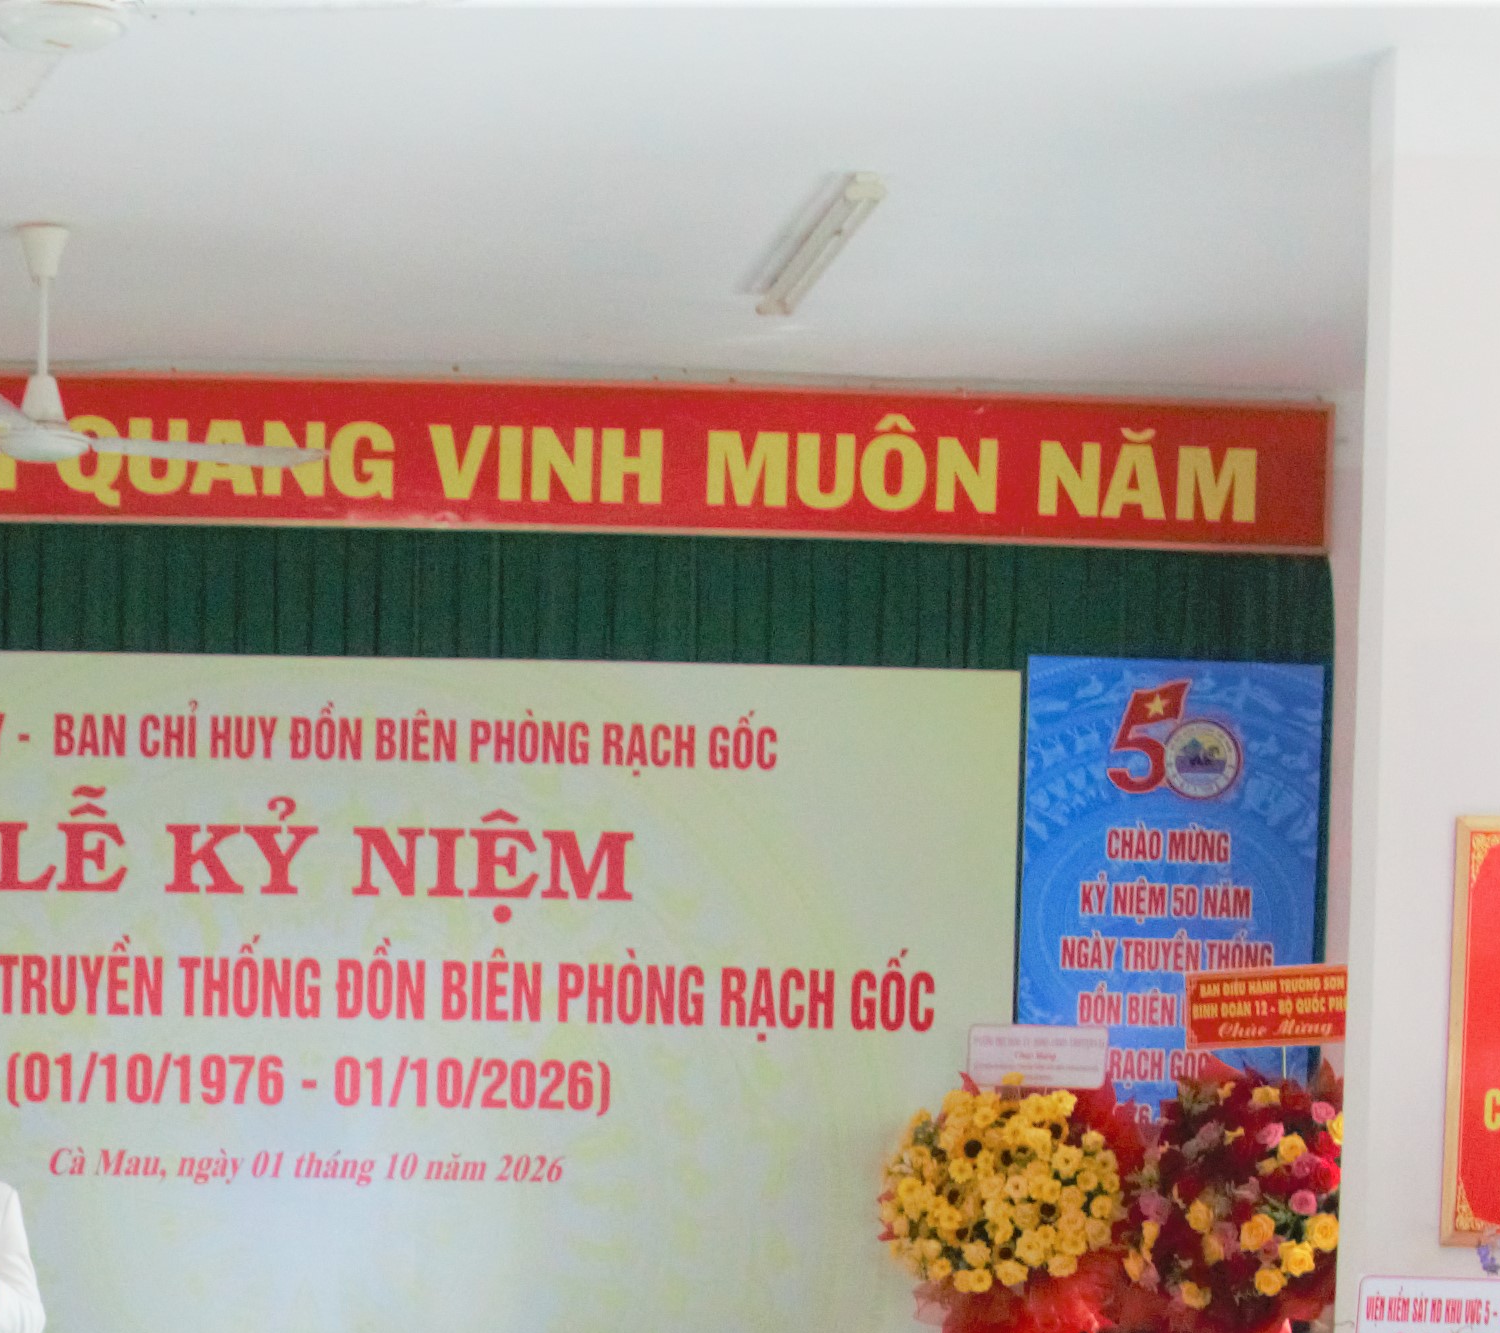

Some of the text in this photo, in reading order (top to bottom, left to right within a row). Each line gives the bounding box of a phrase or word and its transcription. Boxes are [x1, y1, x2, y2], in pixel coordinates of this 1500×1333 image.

[57, 415, 396, 508] QUANG
[428, 424, 664, 506] VINH
[706, 413, 998, 514] MUÔN
[1037, 426, 1258, 523] NĂM
[53, 711, 126, 758] BAN
[139, 699, 199, 759] CHỈ
[209, 715, 278, 760] HUY
[290, 701, 363, 761] ĐỒN
[375, 709, 457, 763] BIÊN
[469, 709, 590, 765] PHÒNG
[602, 722, 696, 777] RẠCH
[708, 711, 778, 770] GỐC
[164, 796, 319, 895] KỶ
[352, 807, 635, 924] NIỆM
[1106, 820, 1232, 864] CHÀO MỪNG
[1079, 871, 1253, 925] KỶ NIỆM 50 NĂM
[1060, 928, 1275, 973] NGÀY TRUYỀN THỐNG
[178, 935, 322, 1019] THỐNG
[336, 938, 427, 1021] ĐỒN
[441, 947, 543, 1022] BIÊN
[557, 948, 705, 1027] PHÒNG
[720, 967, 835, 1042] RẠCH
[850, 948, 935, 1033] GỐC
[1078, 981, 1123, 1026] ĐỒN
[1126, 987, 1177, 1027] BIÊN
[1254, 1000, 1269, 1017] 12
[1218, 1018, 1335, 1039] Chúc Mừng
[6, 1051, 285, 1108] (01/10/1976
[333, 1055, 612, 1117] 01/10/2026)
[1109, 1049, 1166, 1090] RẠCH
[49, 1147, 566, 1187] Cà Mau, ngày 01 tháng 10 năm 2026
[1483, 1299, 1491, 1326] 5
